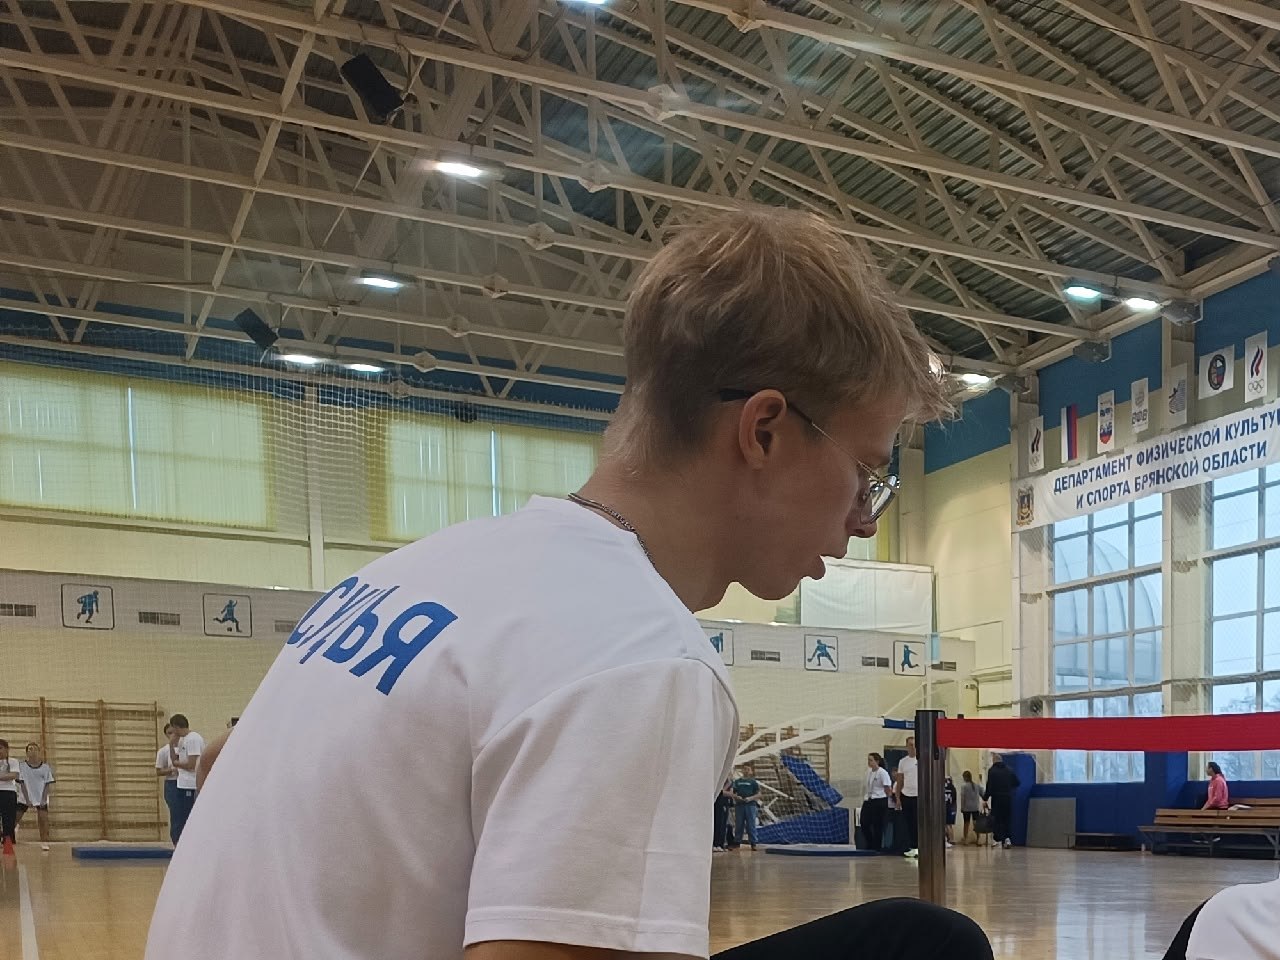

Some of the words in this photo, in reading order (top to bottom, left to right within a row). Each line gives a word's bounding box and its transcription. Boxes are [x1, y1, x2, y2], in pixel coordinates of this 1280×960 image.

[1054, 454, 1133, 495] ДЕПАРТАМЕНТ
[1136, 427, 1220, 466] ФИЗИЧЕСКОЙ
[1076, 495, 1083, 510] И
[1086, 480, 1131, 507] СПОРТА
[1134, 456, 1199, 492] БРЯНСКОЙ
[1202, 440, 1267, 473] ОБЛАСТИ
